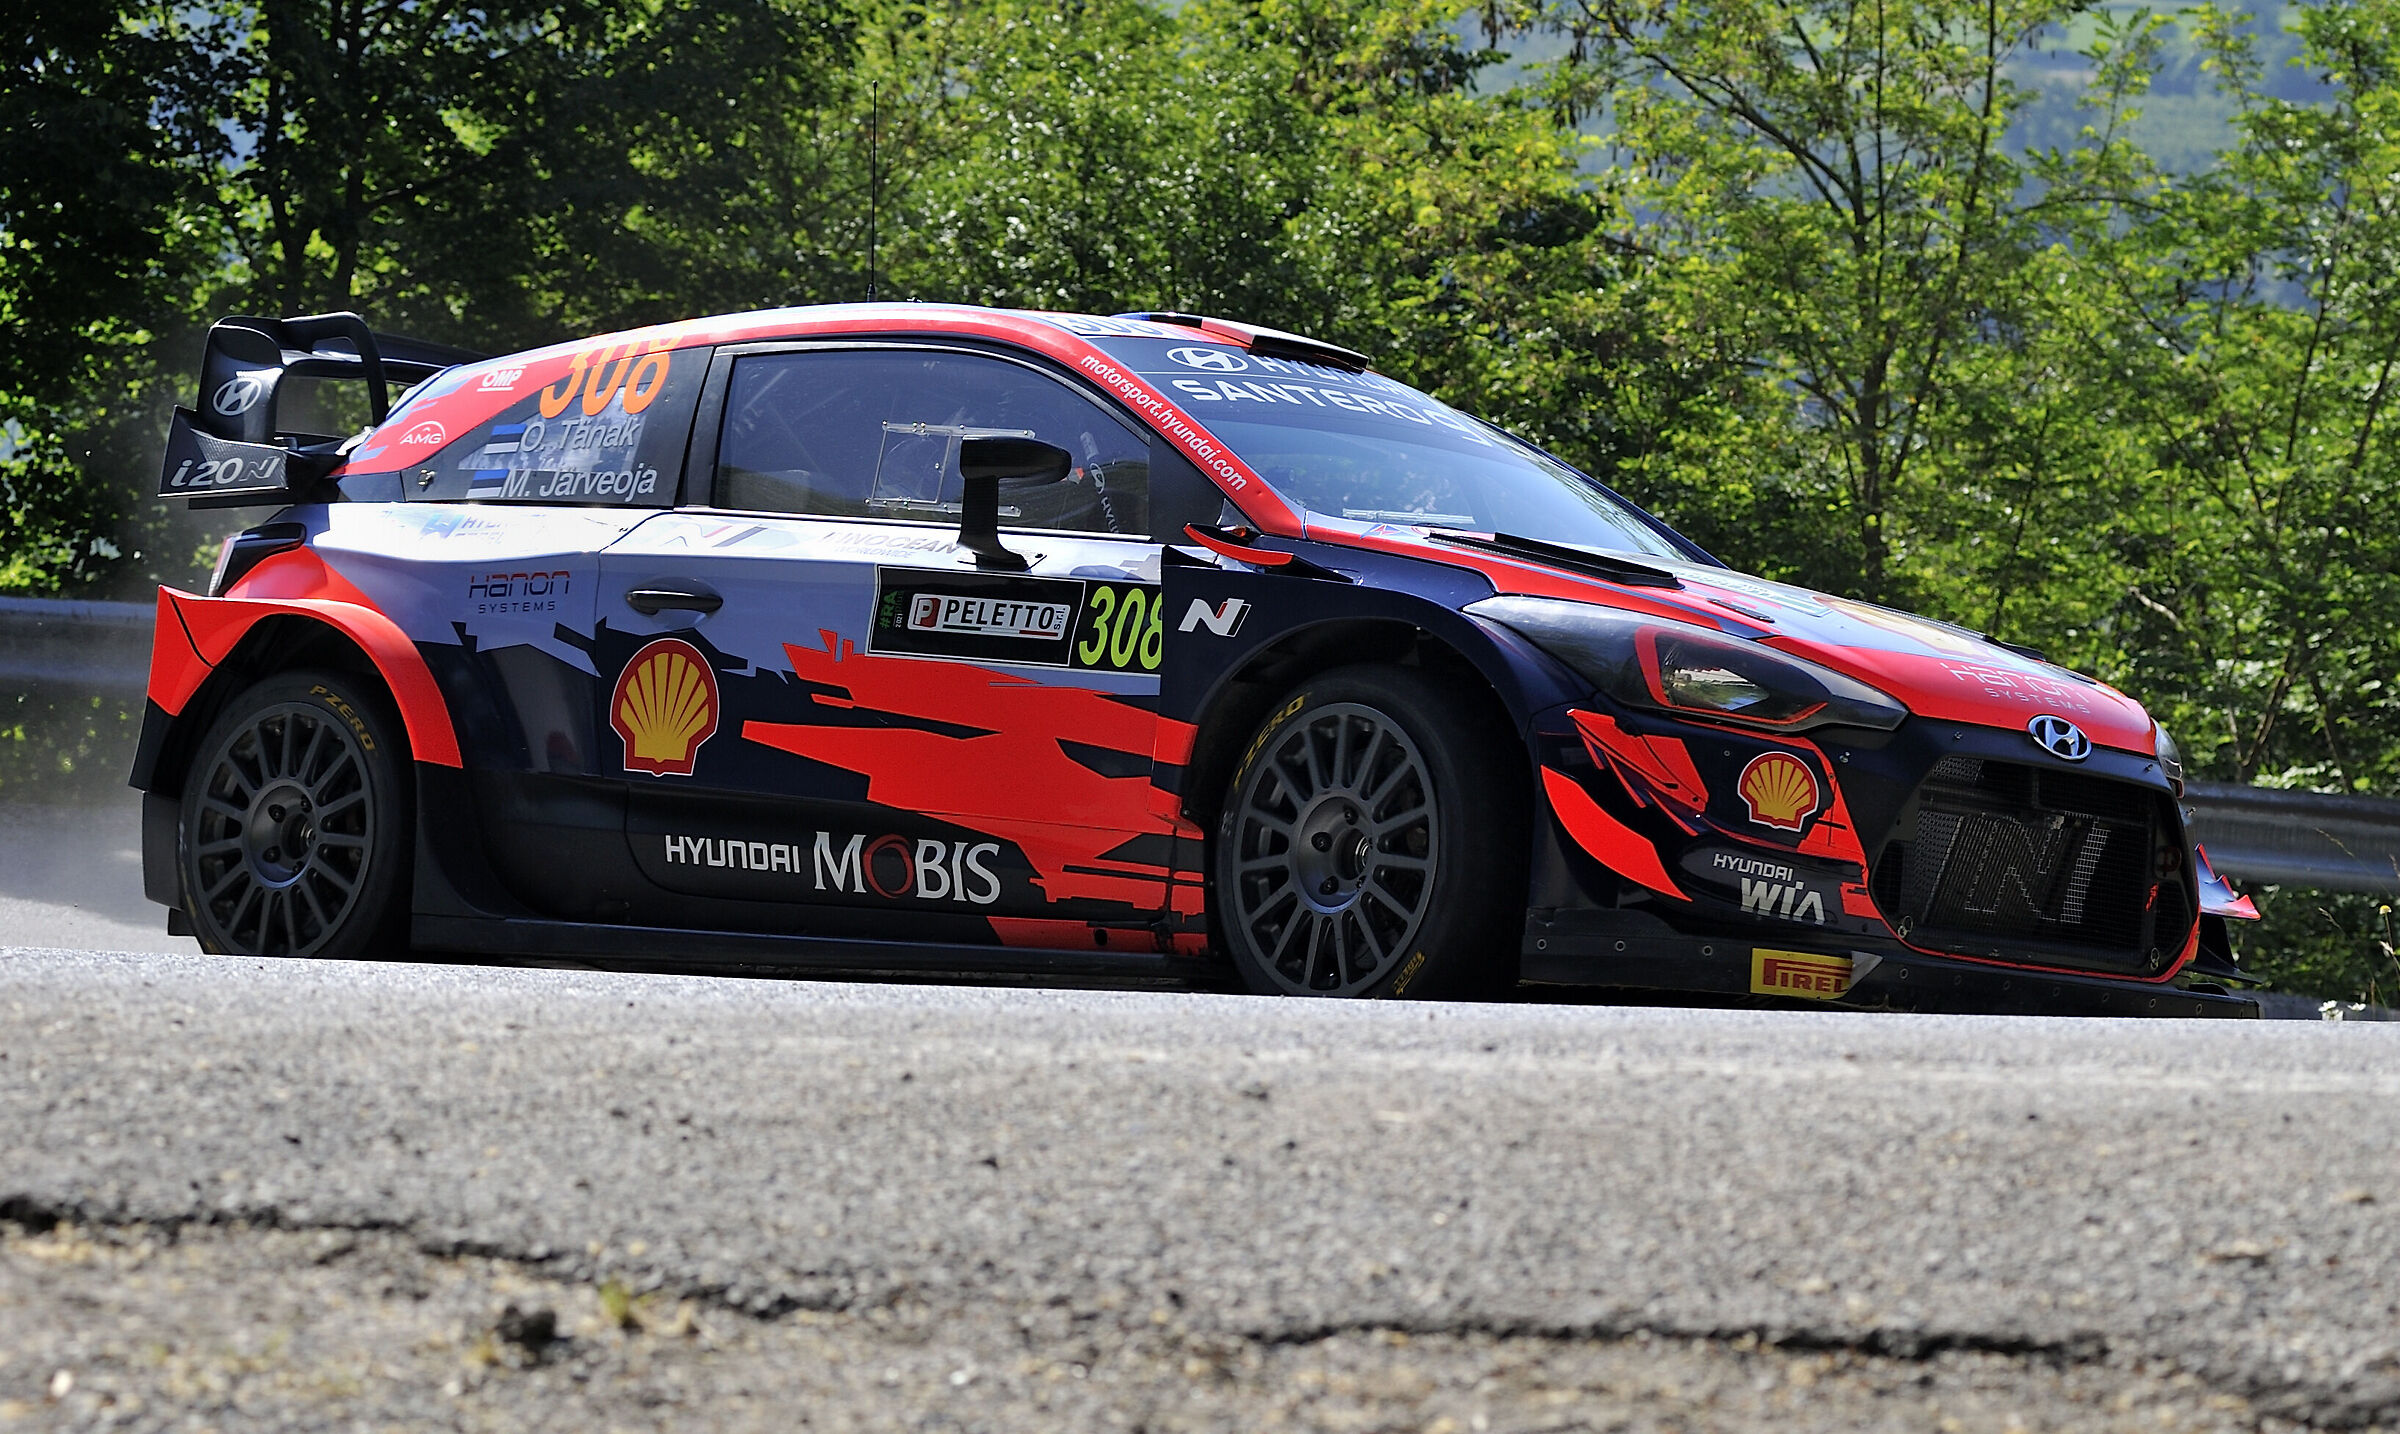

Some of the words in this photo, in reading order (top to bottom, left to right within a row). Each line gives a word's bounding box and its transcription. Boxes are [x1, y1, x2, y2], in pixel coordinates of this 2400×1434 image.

[481, 370, 521, 387] OMP
[520, 421, 544, 452] O.
[559, 417, 640, 450] Tänak
[1081, 354, 1247, 491] motorsport.hyundai.com
[501, 469, 530, 498] M.
[540, 463, 658, 502] Järveoja
[478, 601, 556, 614] SYSTEMS
[944, 599, 1055, 629] PELETTO
[1079, 586, 1162, 670] 308
[1985, 687, 2091, 714] SYSTEMS
[665, 834, 800, 873] HYUNDAI
[813, 831, 1000, 904] MOBIS
[1713, 853, 1794, 882] HYUNDAI
